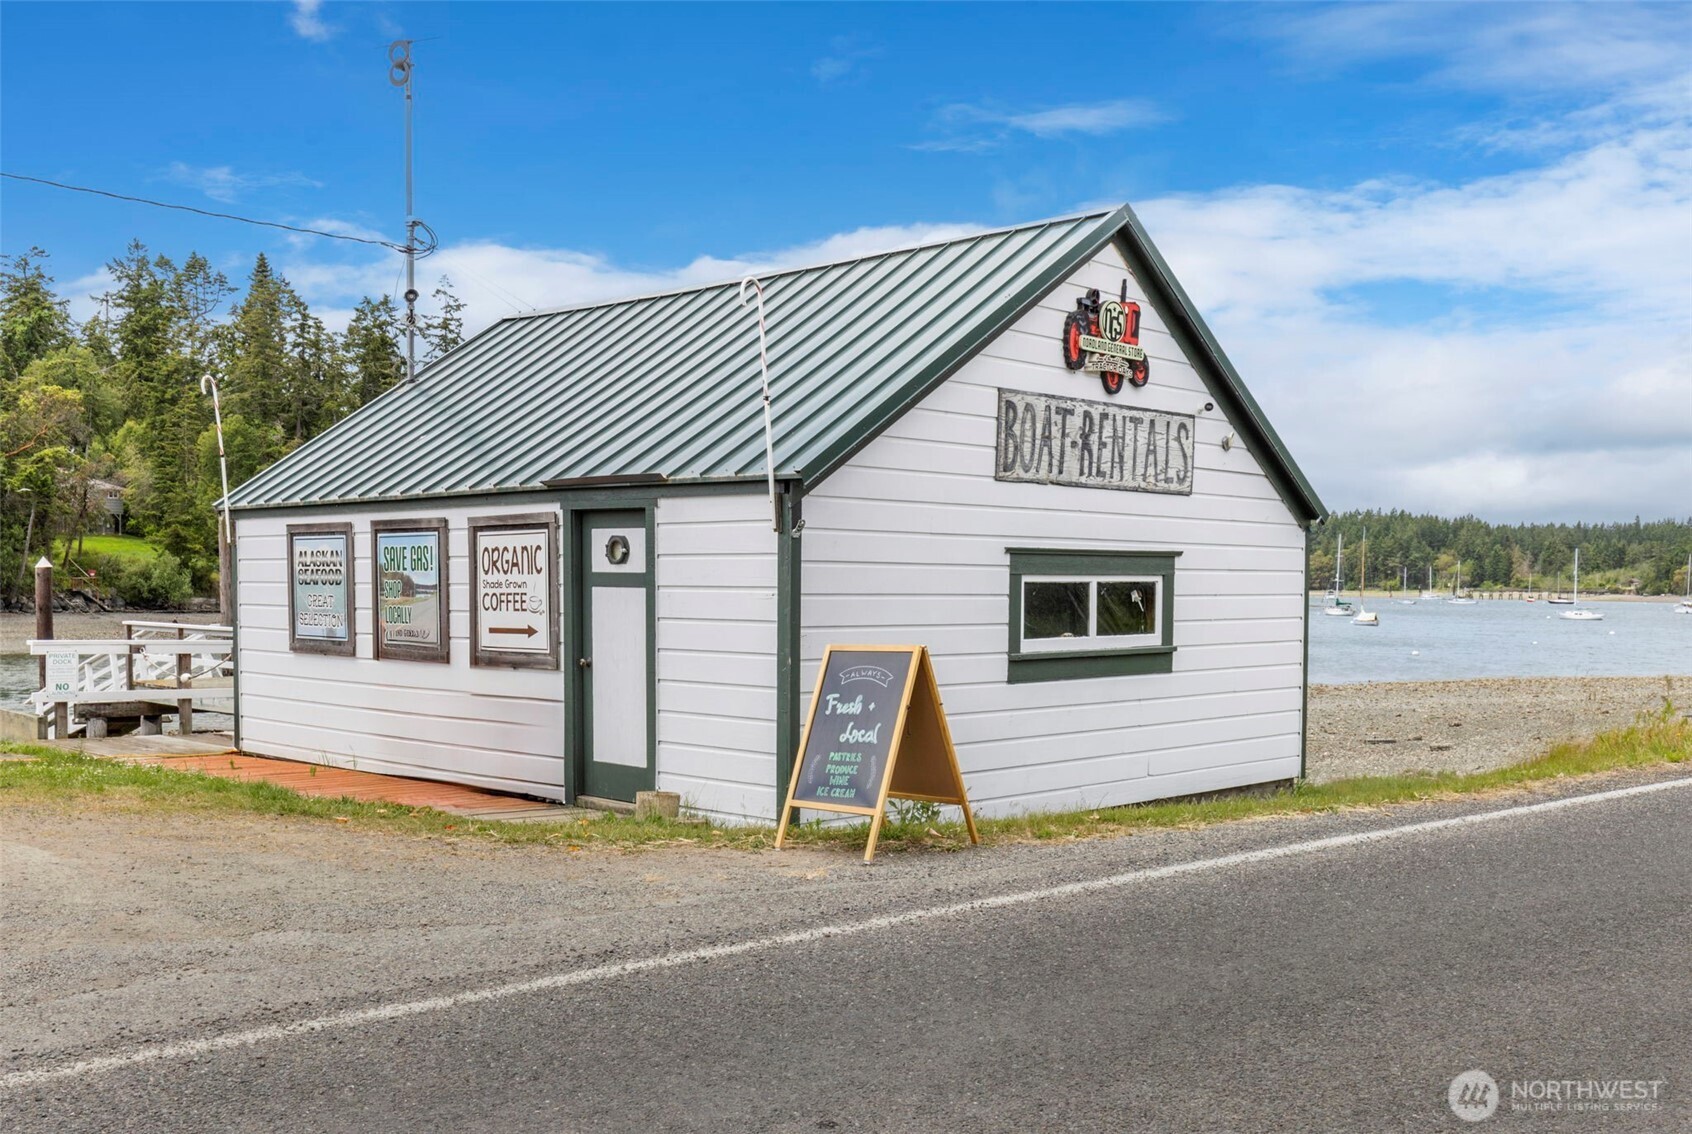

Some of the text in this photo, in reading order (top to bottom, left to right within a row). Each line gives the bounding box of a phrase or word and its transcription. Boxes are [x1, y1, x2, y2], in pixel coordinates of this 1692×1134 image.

[1107, 342, 1127, 355] GENERAL
[1128, 346, 1143, 359] STORE
[297, 549, 343, 568] ALASKAN
[383, 545, 433, 571] SAVE GAS!
[482, 544, 542, 575] ORGANIC
[297, 568, 343, 586] SEAFOOD
[482, 579, 527, 589] Shade Grown
[384, 580, 402, 599] SHOP
[307, 594, 334, 609] GREAT
[482, 592, 527, 612] COFFEE
[299, 612, 343, 628] SELECTION
[385, 606, 412, 625] LOCALLY
[56, 683, 69, 691] NO
[825, 693, 863, 715] Fresh
[839, 722, 882, 744] Local
[829, 752, 862, 763] PASTRIES
[825, 764, 859, 775] PRODUCE
[829, 775, 850, 786] WINE
[816, 786, 856, 798] ICE CREAM
